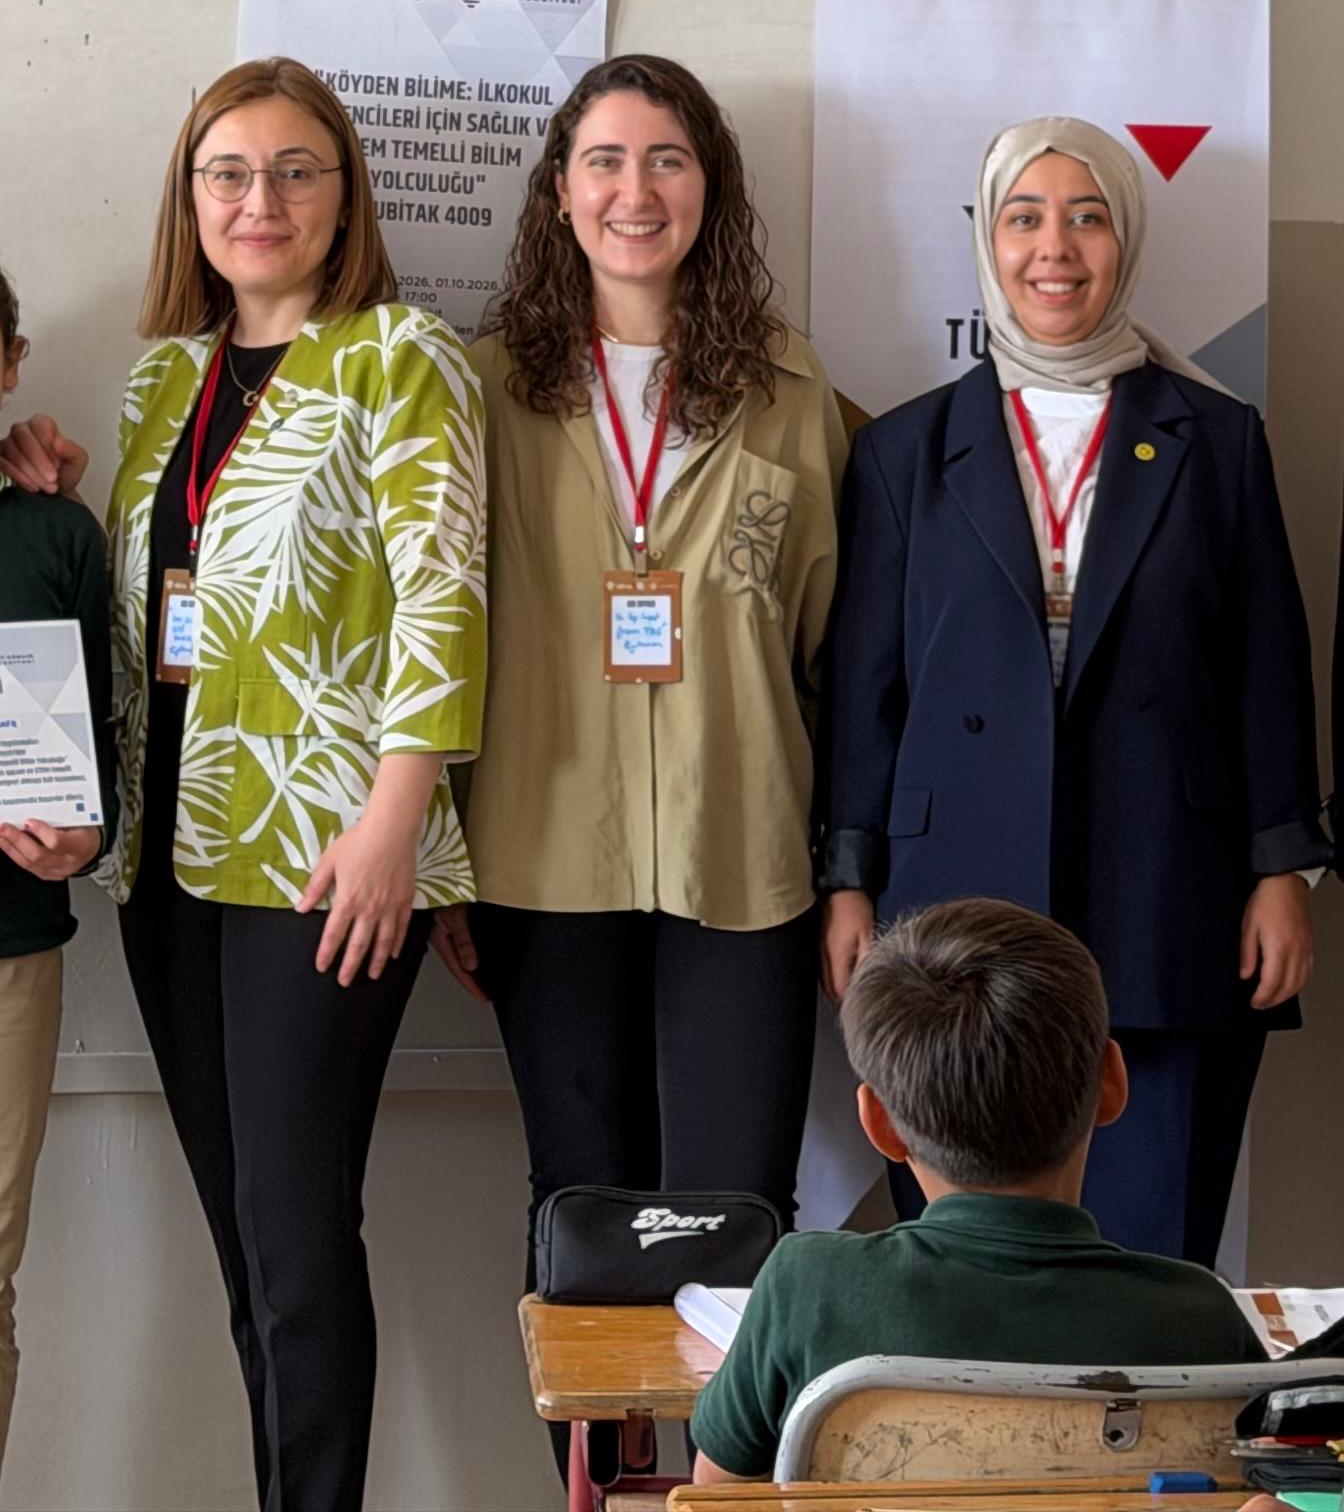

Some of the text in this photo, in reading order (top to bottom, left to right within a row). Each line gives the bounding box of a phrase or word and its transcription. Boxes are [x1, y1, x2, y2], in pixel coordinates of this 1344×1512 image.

[405, 74, 473, 100] BİLİME:
[478, 78, 553, 105] İLKOKUL
[426, 107, 461, 135] İÇİN
[466, 111, 529, 136] SAĞLIK
[536, 118, 548, 137] V
[361, 137, 521, 167] EM TEMELLİ BİLİM
[371, 169, 486, 194] YOLCULUĞU"
[375, 197, 492, 227] UBİTAK 4009
[398, 275, 432, 289] 2026,
[631, 1208, 726, 1231] Sport
